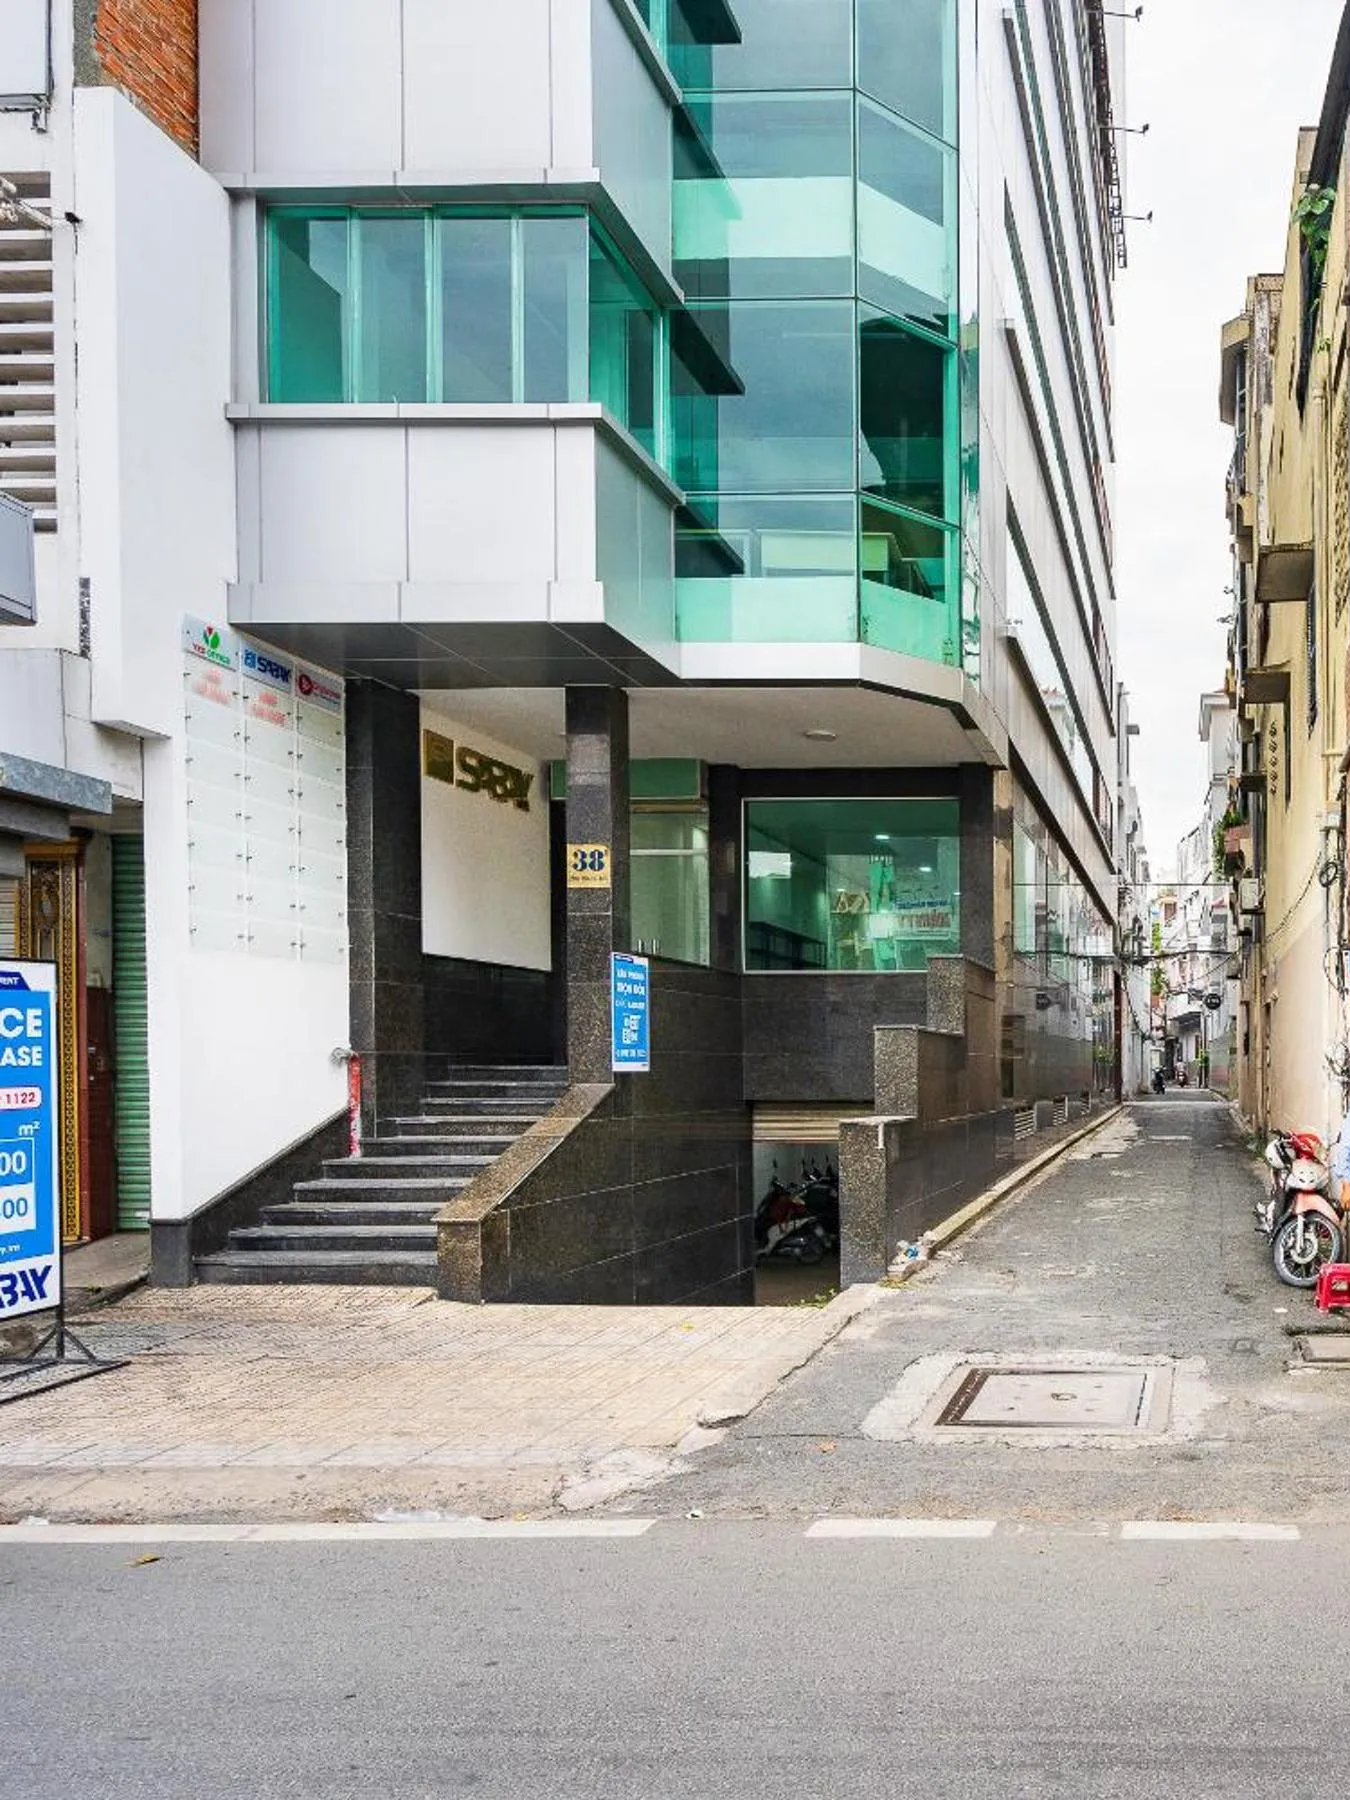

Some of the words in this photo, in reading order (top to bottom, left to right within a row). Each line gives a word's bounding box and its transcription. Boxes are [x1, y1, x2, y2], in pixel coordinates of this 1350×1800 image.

[573, 849, 604, 871] 38
[0, 1007, 43, 1038] CE
[0, 1265, 52, 1310] BAY
